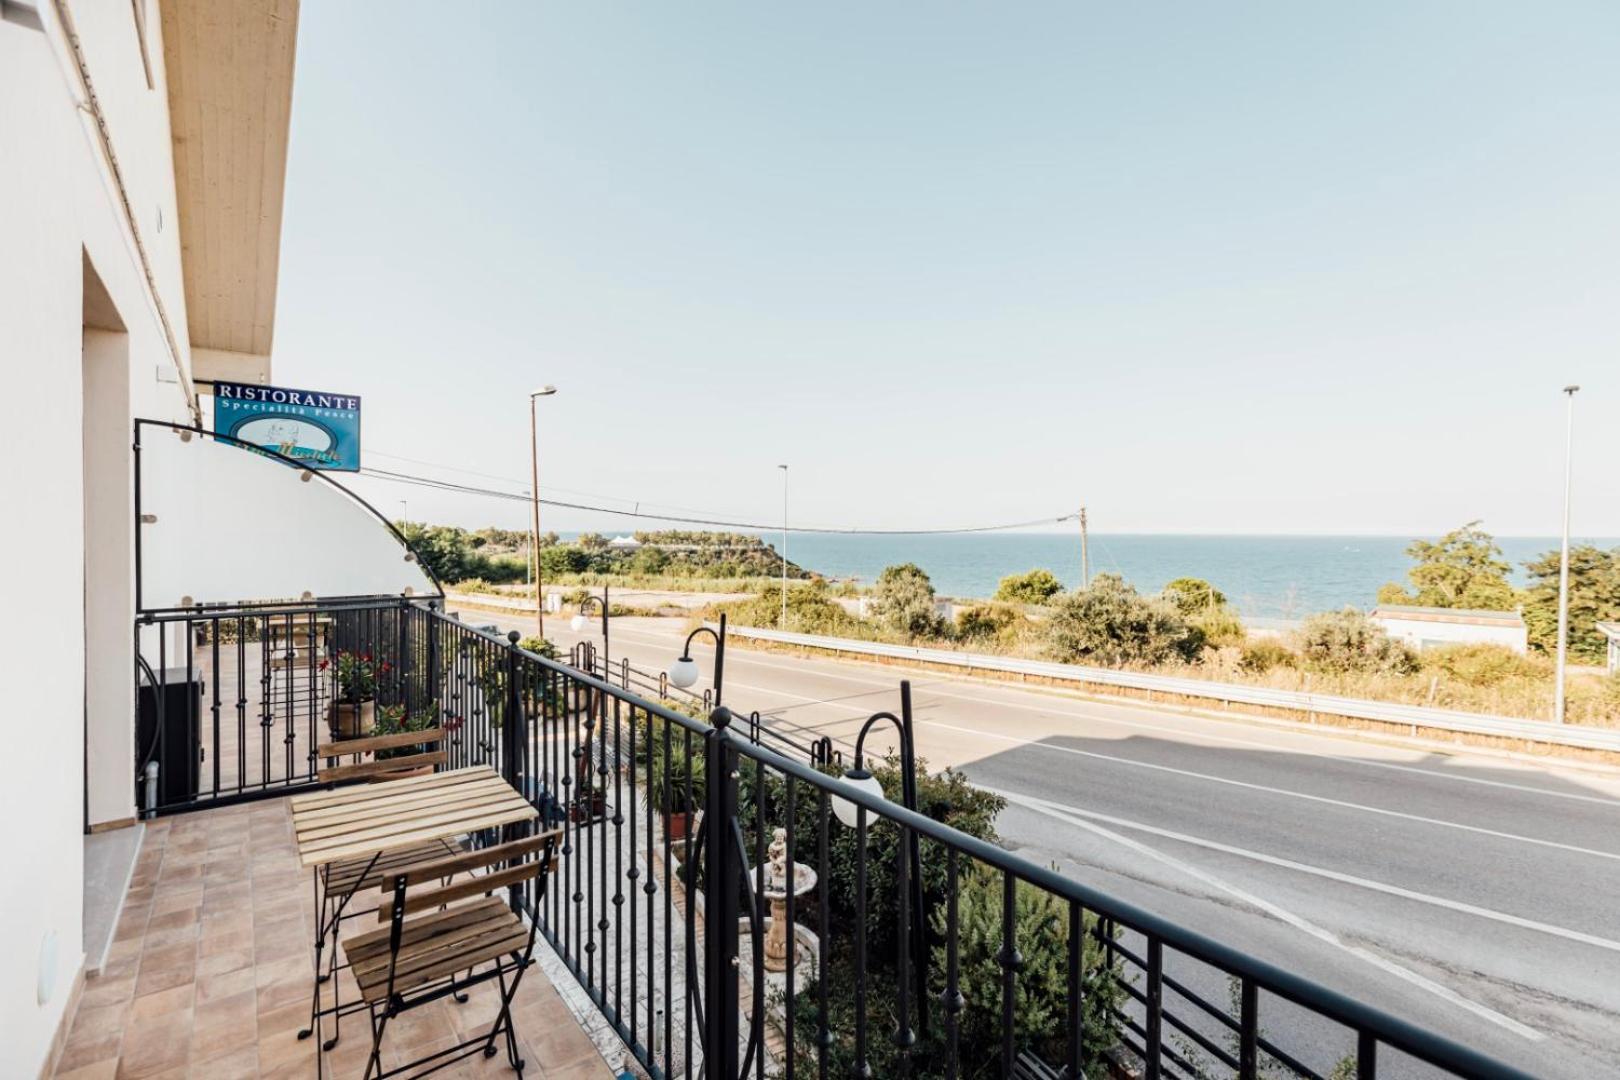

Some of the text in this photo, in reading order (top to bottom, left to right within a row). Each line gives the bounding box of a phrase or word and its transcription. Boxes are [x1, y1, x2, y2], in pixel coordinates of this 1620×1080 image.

[219, 385, 358, 410] RISTORANTE
[222, 399, 355, 419] Specialità Pesce
